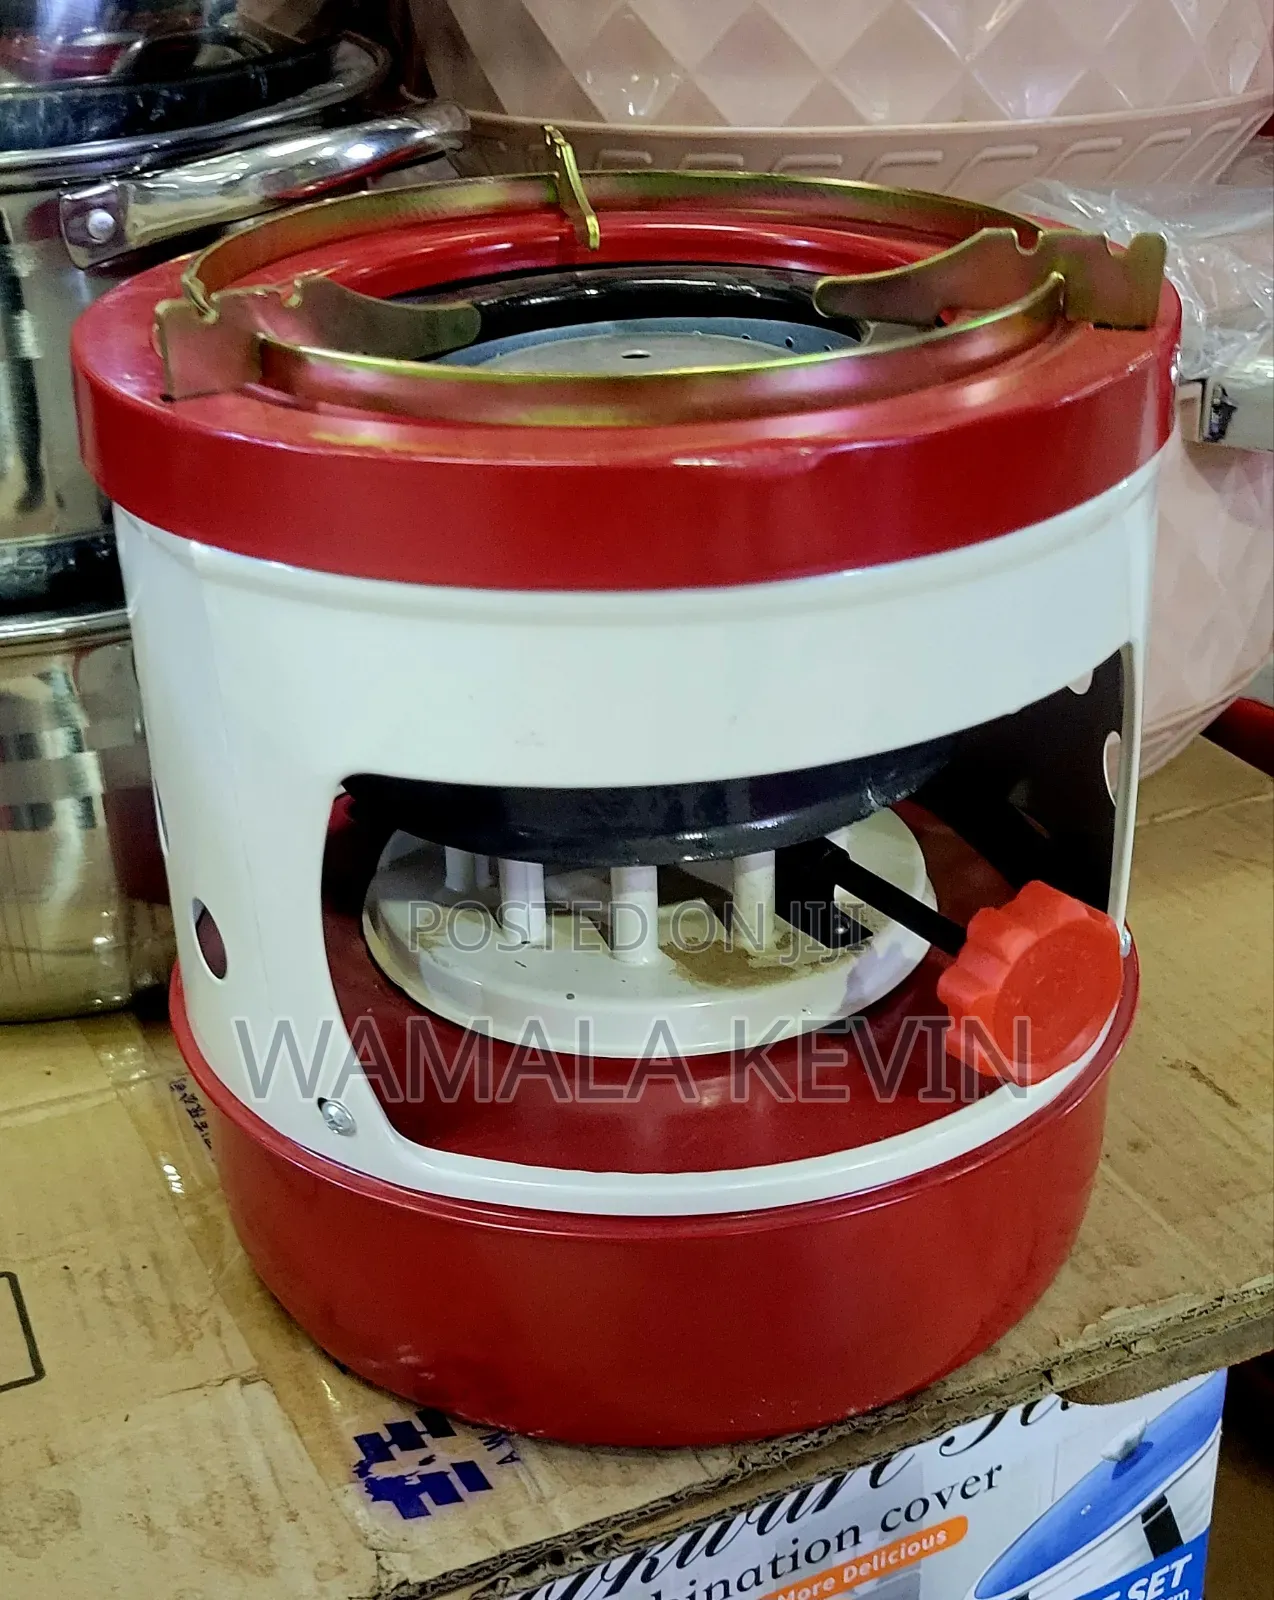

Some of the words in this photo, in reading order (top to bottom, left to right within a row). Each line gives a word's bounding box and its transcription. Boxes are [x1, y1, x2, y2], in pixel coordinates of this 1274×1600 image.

[650, 1523, 863, 1600] ination
[880, 1463, 1003, 1533] cover
[842, 1528, 948, 1584] Delicious
[1127, 1552, 1193, 1600] SET
